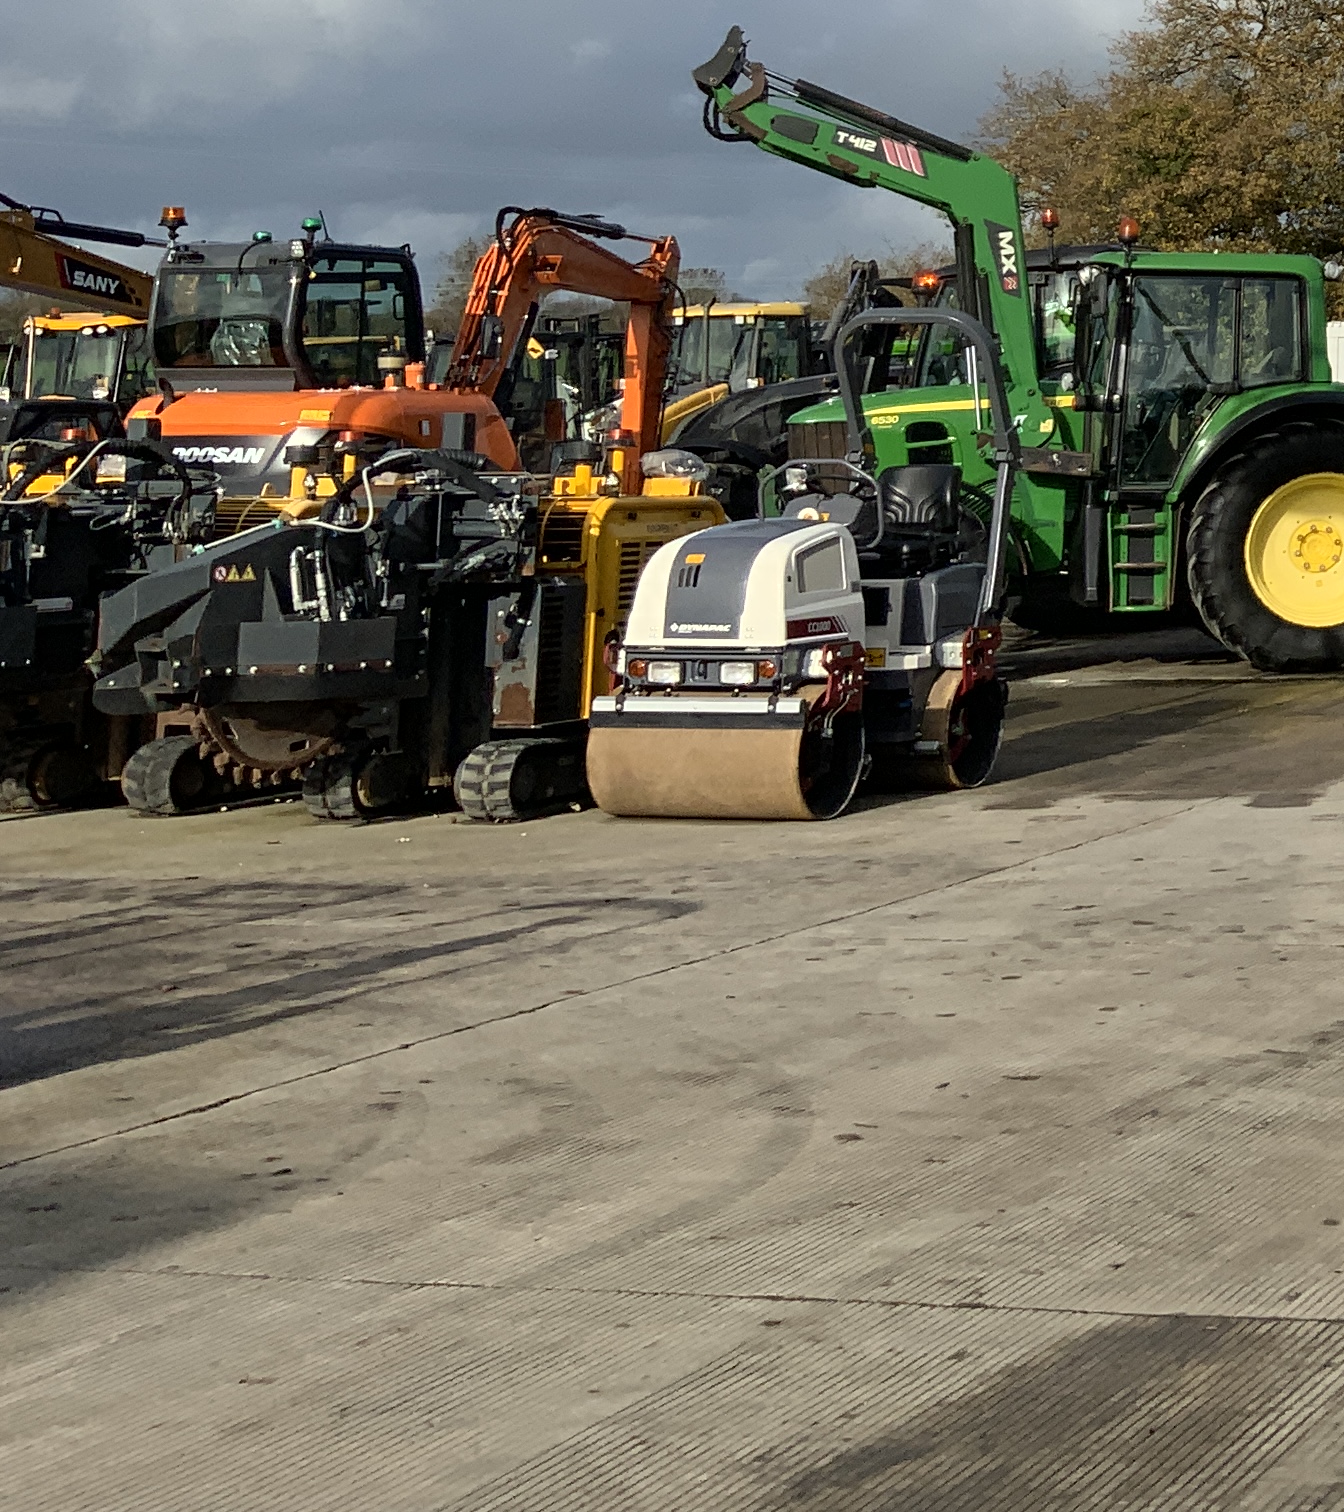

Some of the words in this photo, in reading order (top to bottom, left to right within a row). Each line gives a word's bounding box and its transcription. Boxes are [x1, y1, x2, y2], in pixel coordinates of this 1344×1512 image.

[998, 231, 1017, 276] MX
[73, 270, 119, 294] SANY
[871, 415, 899, 424] 6530
[678, 623, 732, 632] DYNAPAC
